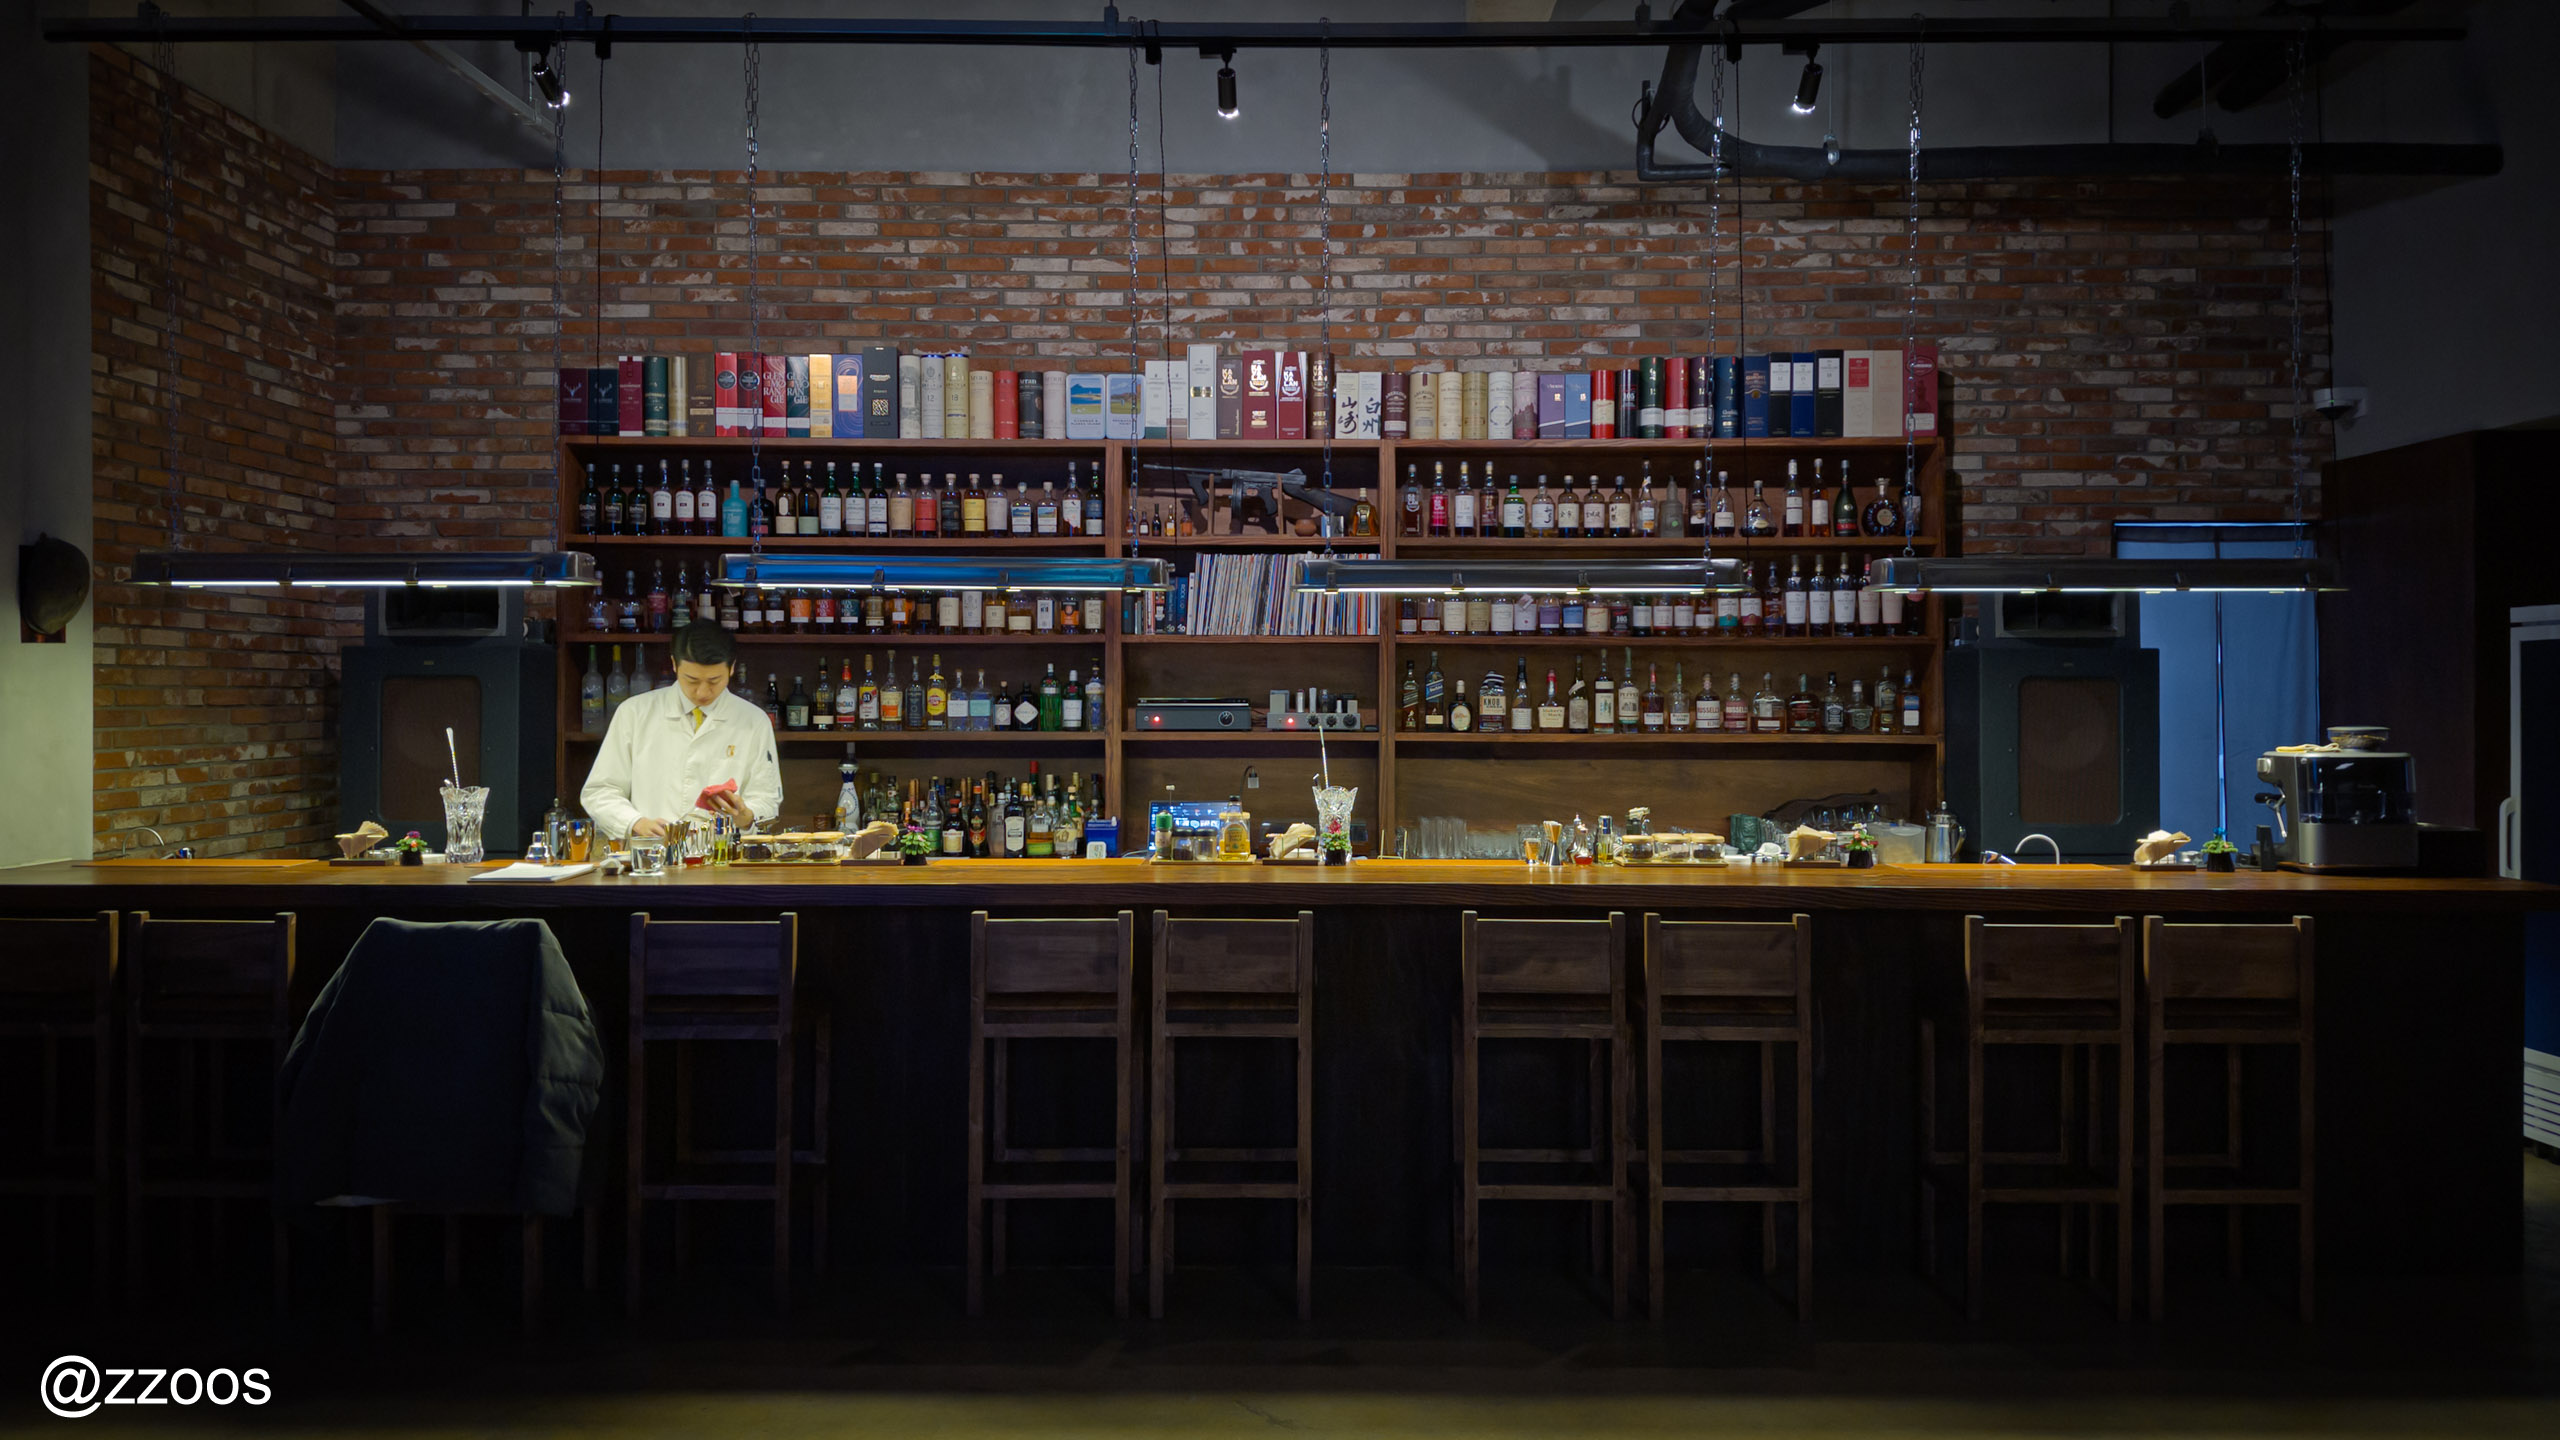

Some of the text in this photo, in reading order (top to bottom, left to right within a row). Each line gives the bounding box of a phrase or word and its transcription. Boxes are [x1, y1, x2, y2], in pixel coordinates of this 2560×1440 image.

[763, 372, 785, 380] GLEN
[771, 380, 786, 388] MO
[763, 387, 781, 396] RAN
[787, 388, 804, 396] RAN
[770, 395, 785, 404] GIE
[794, 395, 809, 404] GIE
[1616, 615, 1628, 623] 105
